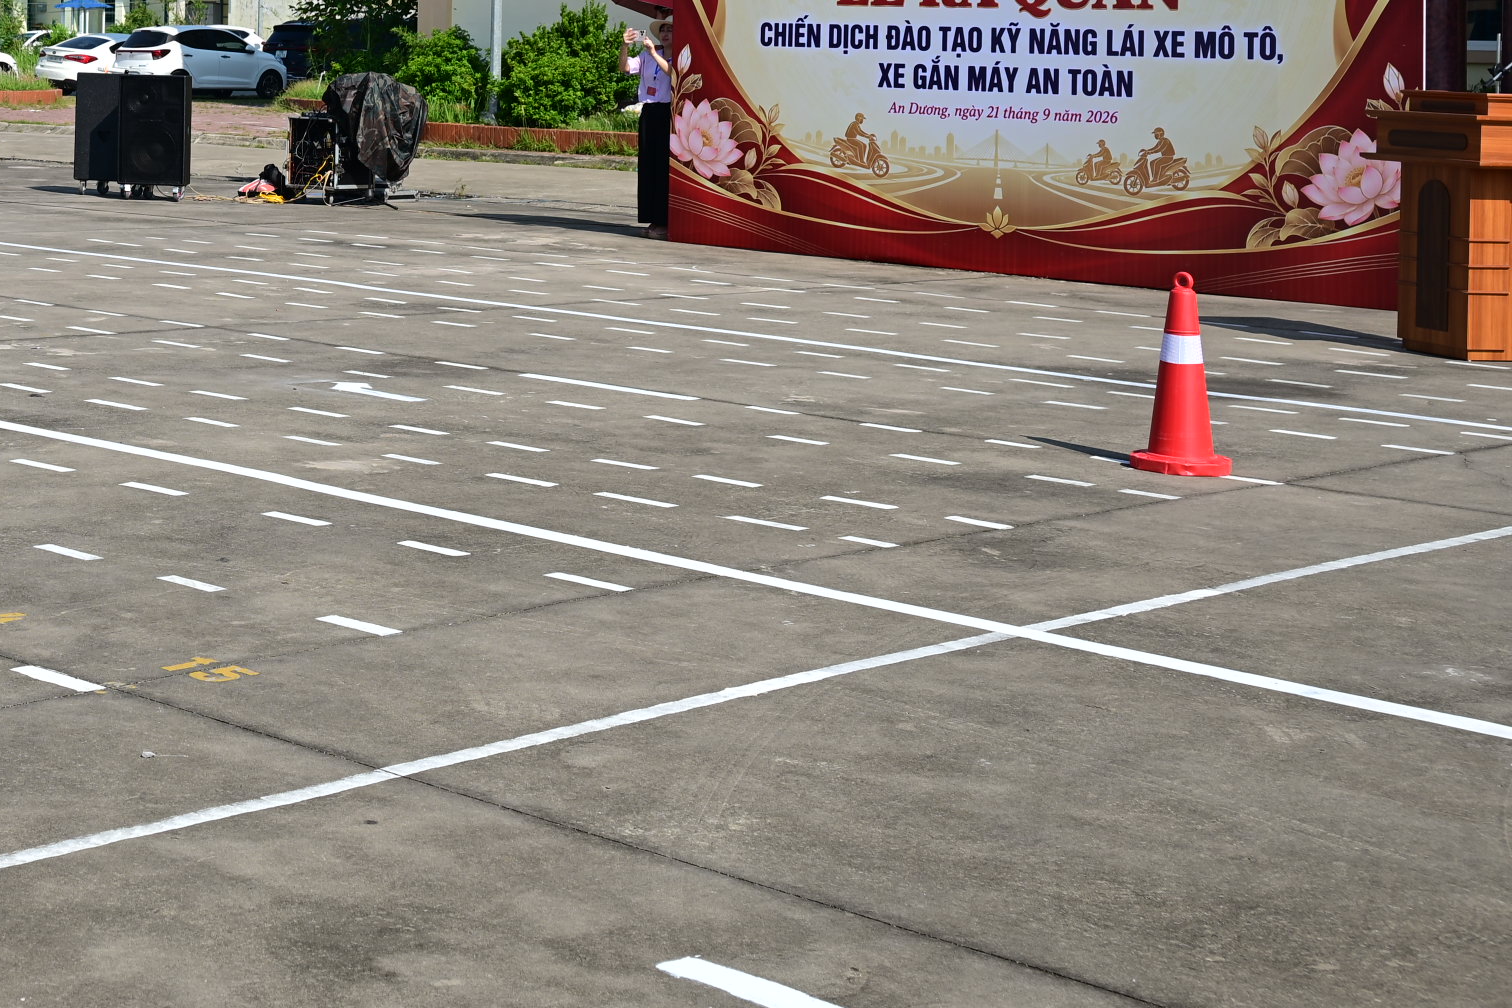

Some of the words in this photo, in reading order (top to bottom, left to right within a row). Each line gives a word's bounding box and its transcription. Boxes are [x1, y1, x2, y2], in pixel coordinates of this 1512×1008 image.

[760, 15, 821, 48] CHIẾN
[829, 24, 879, 54] DỊCH
[886, 20, 931, 51] ĐÀO
[939, 26, 983, 58] TẠO
[991, 22, 1022, 54] KỸ
[1029, 23, 1097, 56] NĂNG
[1107, 24, 1145, 57] LÁI
[1153, 30, 1185, 58] XE
[1194, 25, 1235, 59] MÔ
[1243, 26, 1284, 64] TÔ,
[878, 62, 906, 89] XE
[913, 56, 959, 91] GẮN
[967, 61, 1019, 94] MÁY
[1026, 68, 1059, 95] AN
[1068, 64, 1133, 98] TOÀN
[888, 101, 906, 114] An
[909, 102, 951, 119] Dương,
[954, 107, 984, 121] ngày
[986, 105, 1000, 119] 21
[1003, 105, 1039, 124] tháng
[1042, 108, 1051, 121] 9
[1054, 109, 1083, 123] năm
[1086, 110, 1119, 124] 2026
[160, 656, 261, 683] 15
